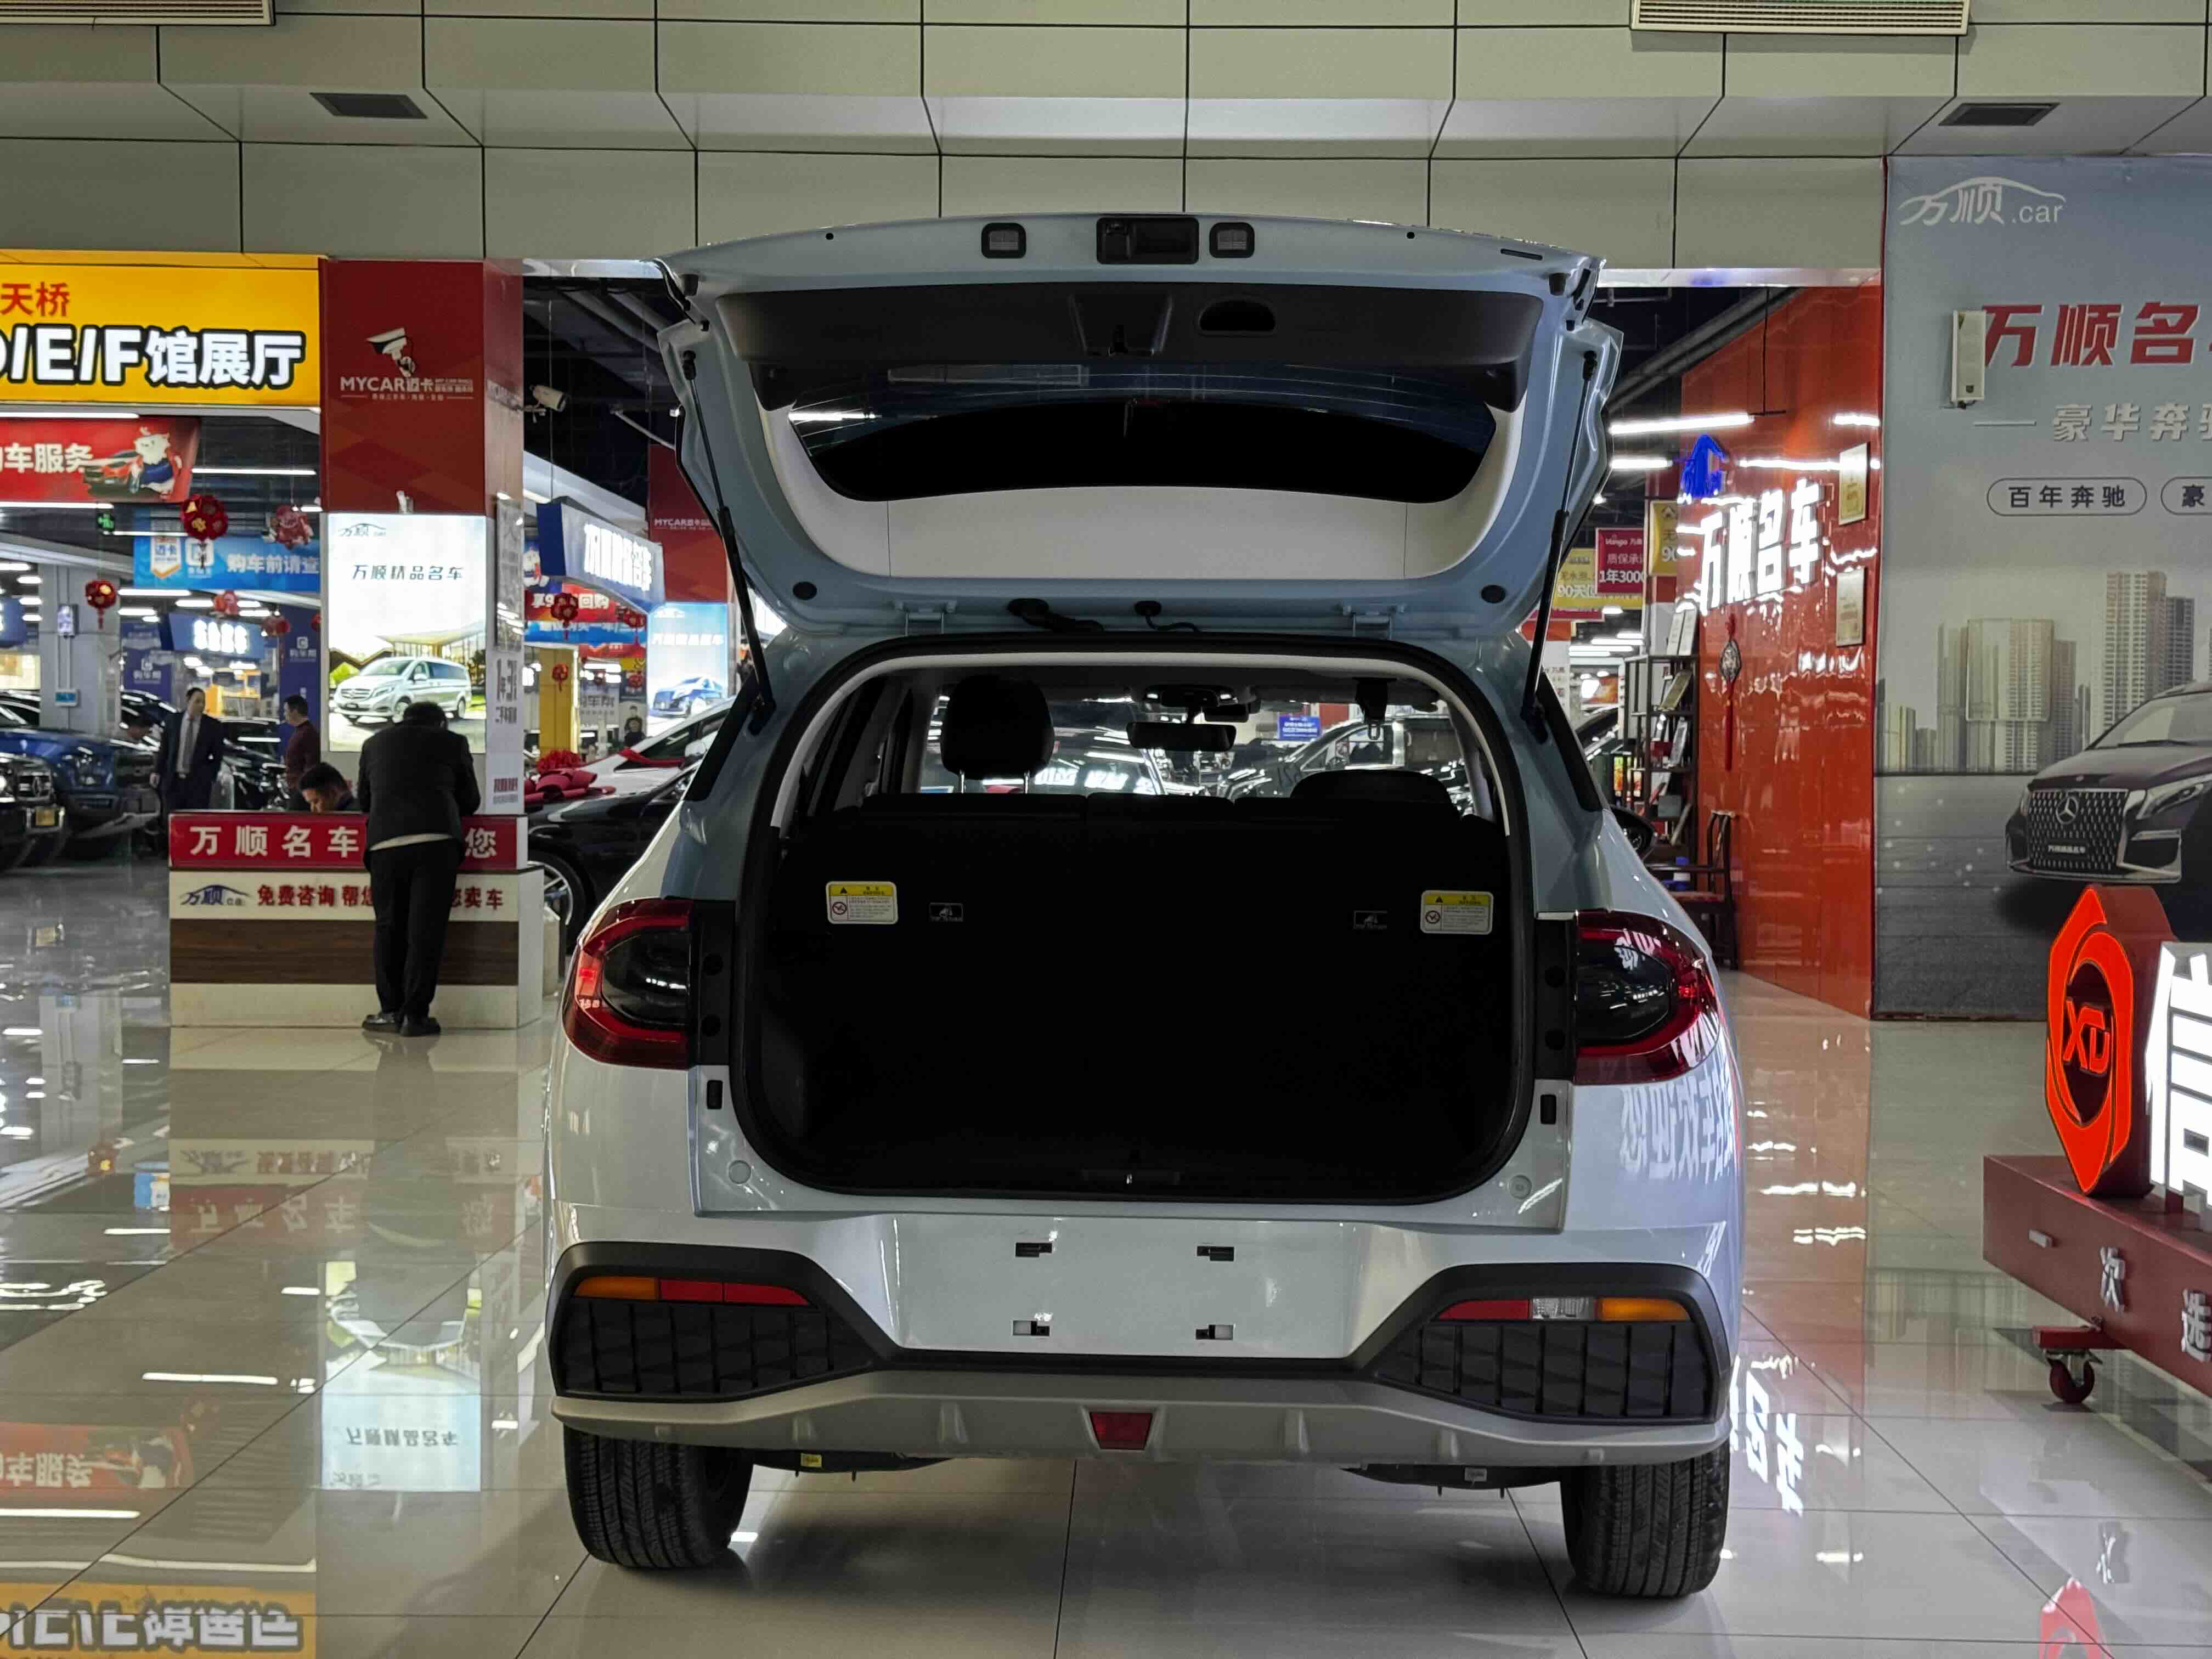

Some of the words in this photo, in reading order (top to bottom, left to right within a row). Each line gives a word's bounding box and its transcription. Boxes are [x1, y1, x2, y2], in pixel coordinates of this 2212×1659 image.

[1, 282, 70, 317] 天桥
[1981, 302, 2212, 367] 万顺名
[0, 325, 303, 386] /E/F馆展厅
[0, 443, 93, 473] 车服务
[2008, 486, 2126, 509] 百年奔驰
[1607, 552, 1643, 565] 质保承
[189, 826, 359, 858] 万顺名车
[465, 827, 497, 858] 您
[257, 884, 335, 907] 免费咨询
